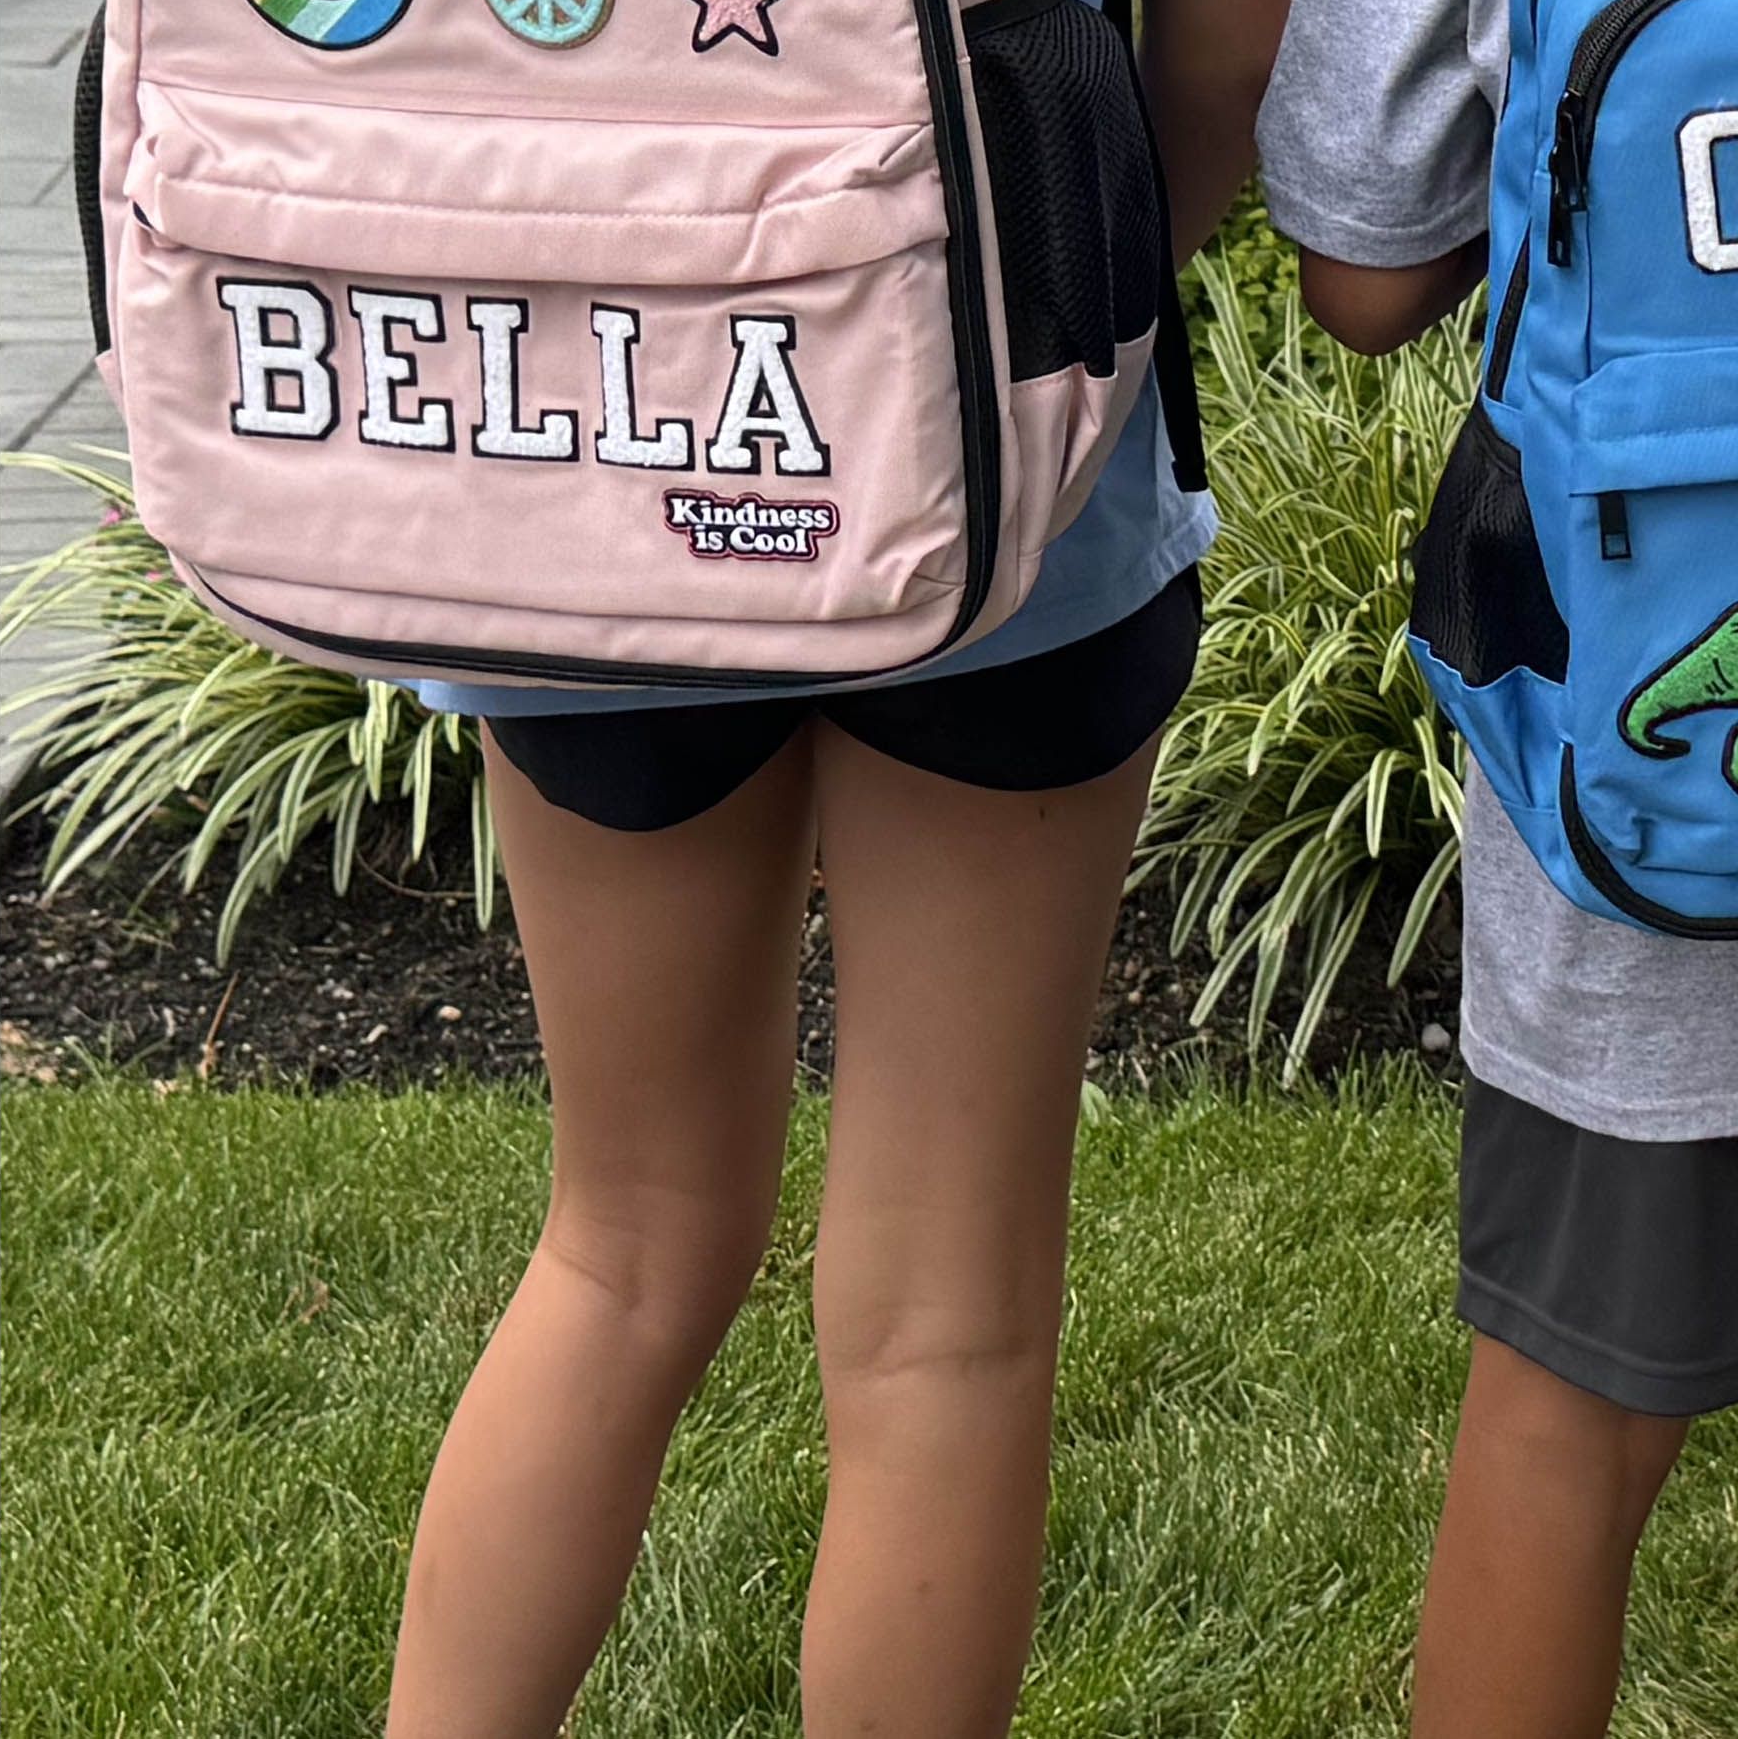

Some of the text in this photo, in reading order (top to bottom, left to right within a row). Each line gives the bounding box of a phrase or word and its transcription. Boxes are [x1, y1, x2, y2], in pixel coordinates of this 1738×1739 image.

[217, 276, 831, 477] BELLA
[670, 497, 831, 529] Kindness
[694, 525, 809, 553] is Cool
